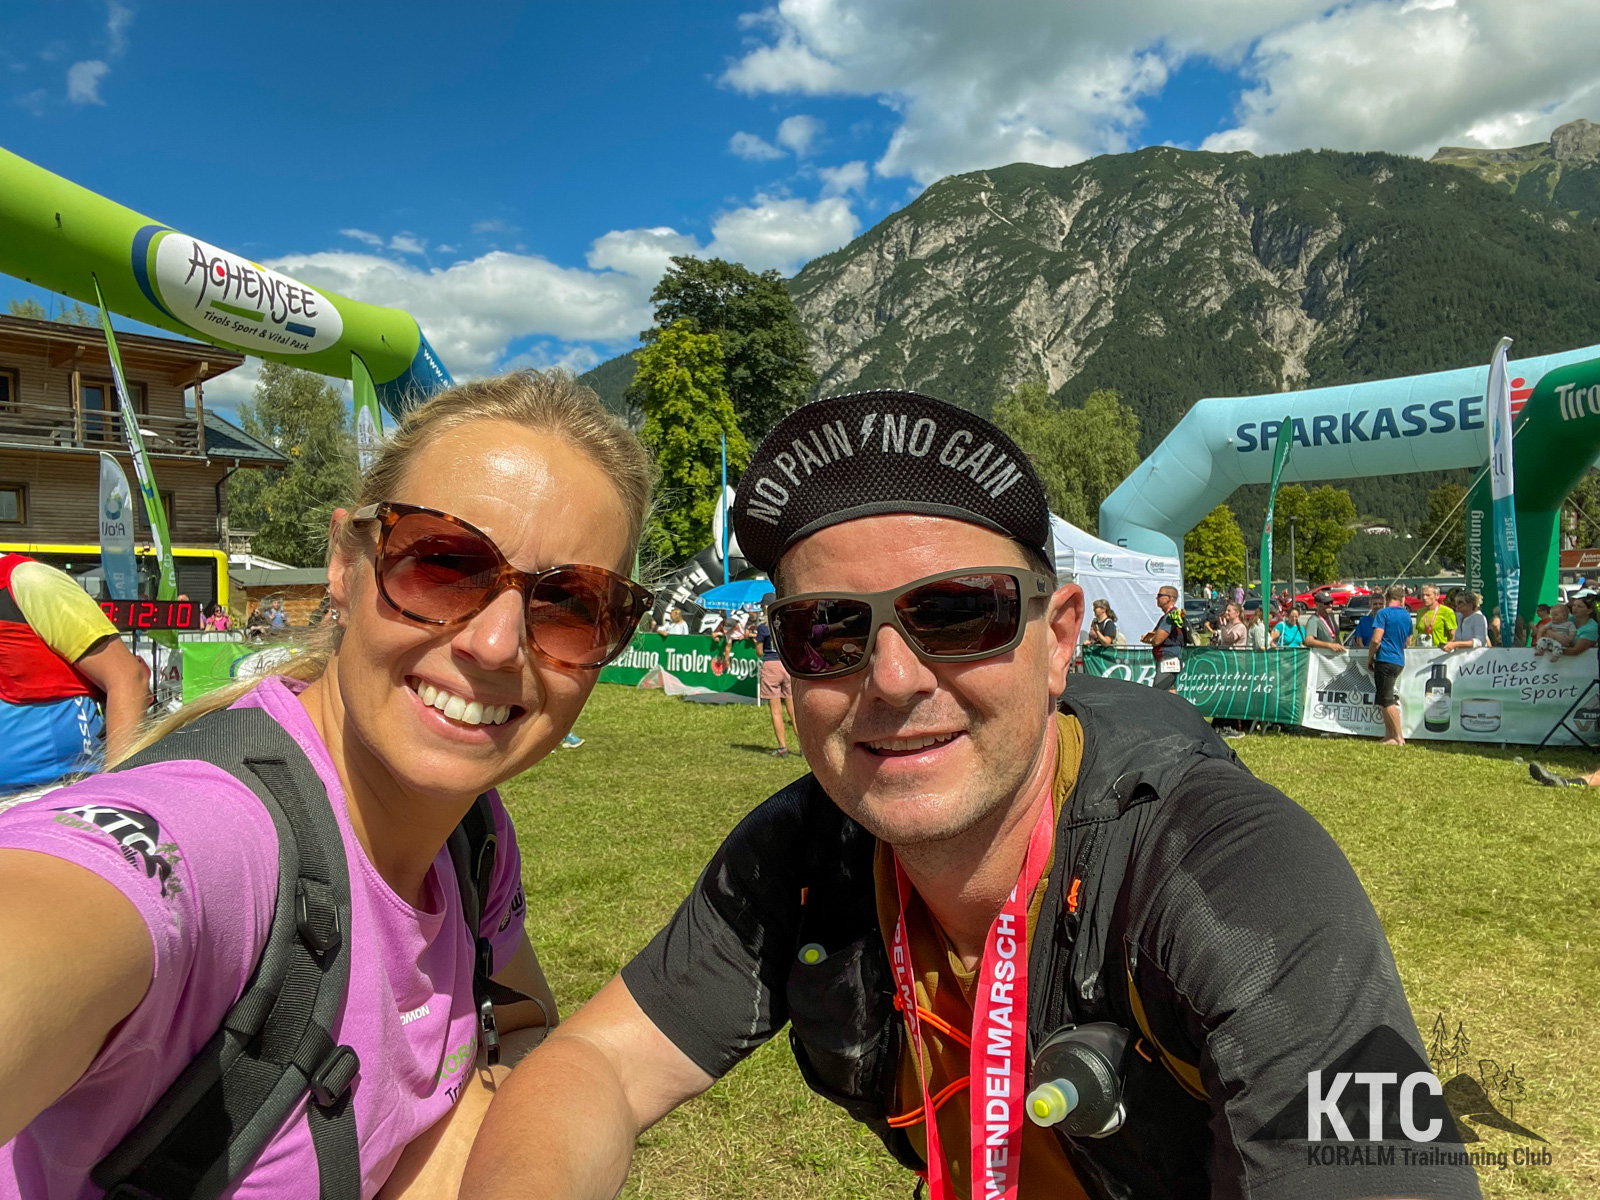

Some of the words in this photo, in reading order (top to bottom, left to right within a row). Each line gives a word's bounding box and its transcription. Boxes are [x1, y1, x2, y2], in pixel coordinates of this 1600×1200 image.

[184, 241, 319, 324] ACHENSEE
[203, 310, 231, 327] Tirols
[231, 321, 258, 338] Sport
[258, 329, 267, 338] &
[268, 331, 291, 345] Vital
[290, 338, 310, 351] Park
[1236, 395, 1485, 452] SPARKASSE
[746, 476, 789, 526] NO
[773, 420, 854, 486] PAIN
[881, 413, 937, 458] NO
[938, 429, 1024, 500] GAIN
[1470, 509, 1484, 596] geszeitung
[666, 647, 712, 673] Tiroler
[1179, 671, 1275, 682] Österreichische
[1459, 660, 1537, 677] Wellness
[1177, 682, 1248, 694] Bundesforste
[1253, 684, 1274, 694] AG
[1316, 686, 1399, 706] TIROL
[1492, 673, 1559, 688] Fitness
[1521, 685, 1579, 704] Sport
[62, 804, 157, 856] KTC
[985, 913, 1017, 1200] WENDELMARSCH
